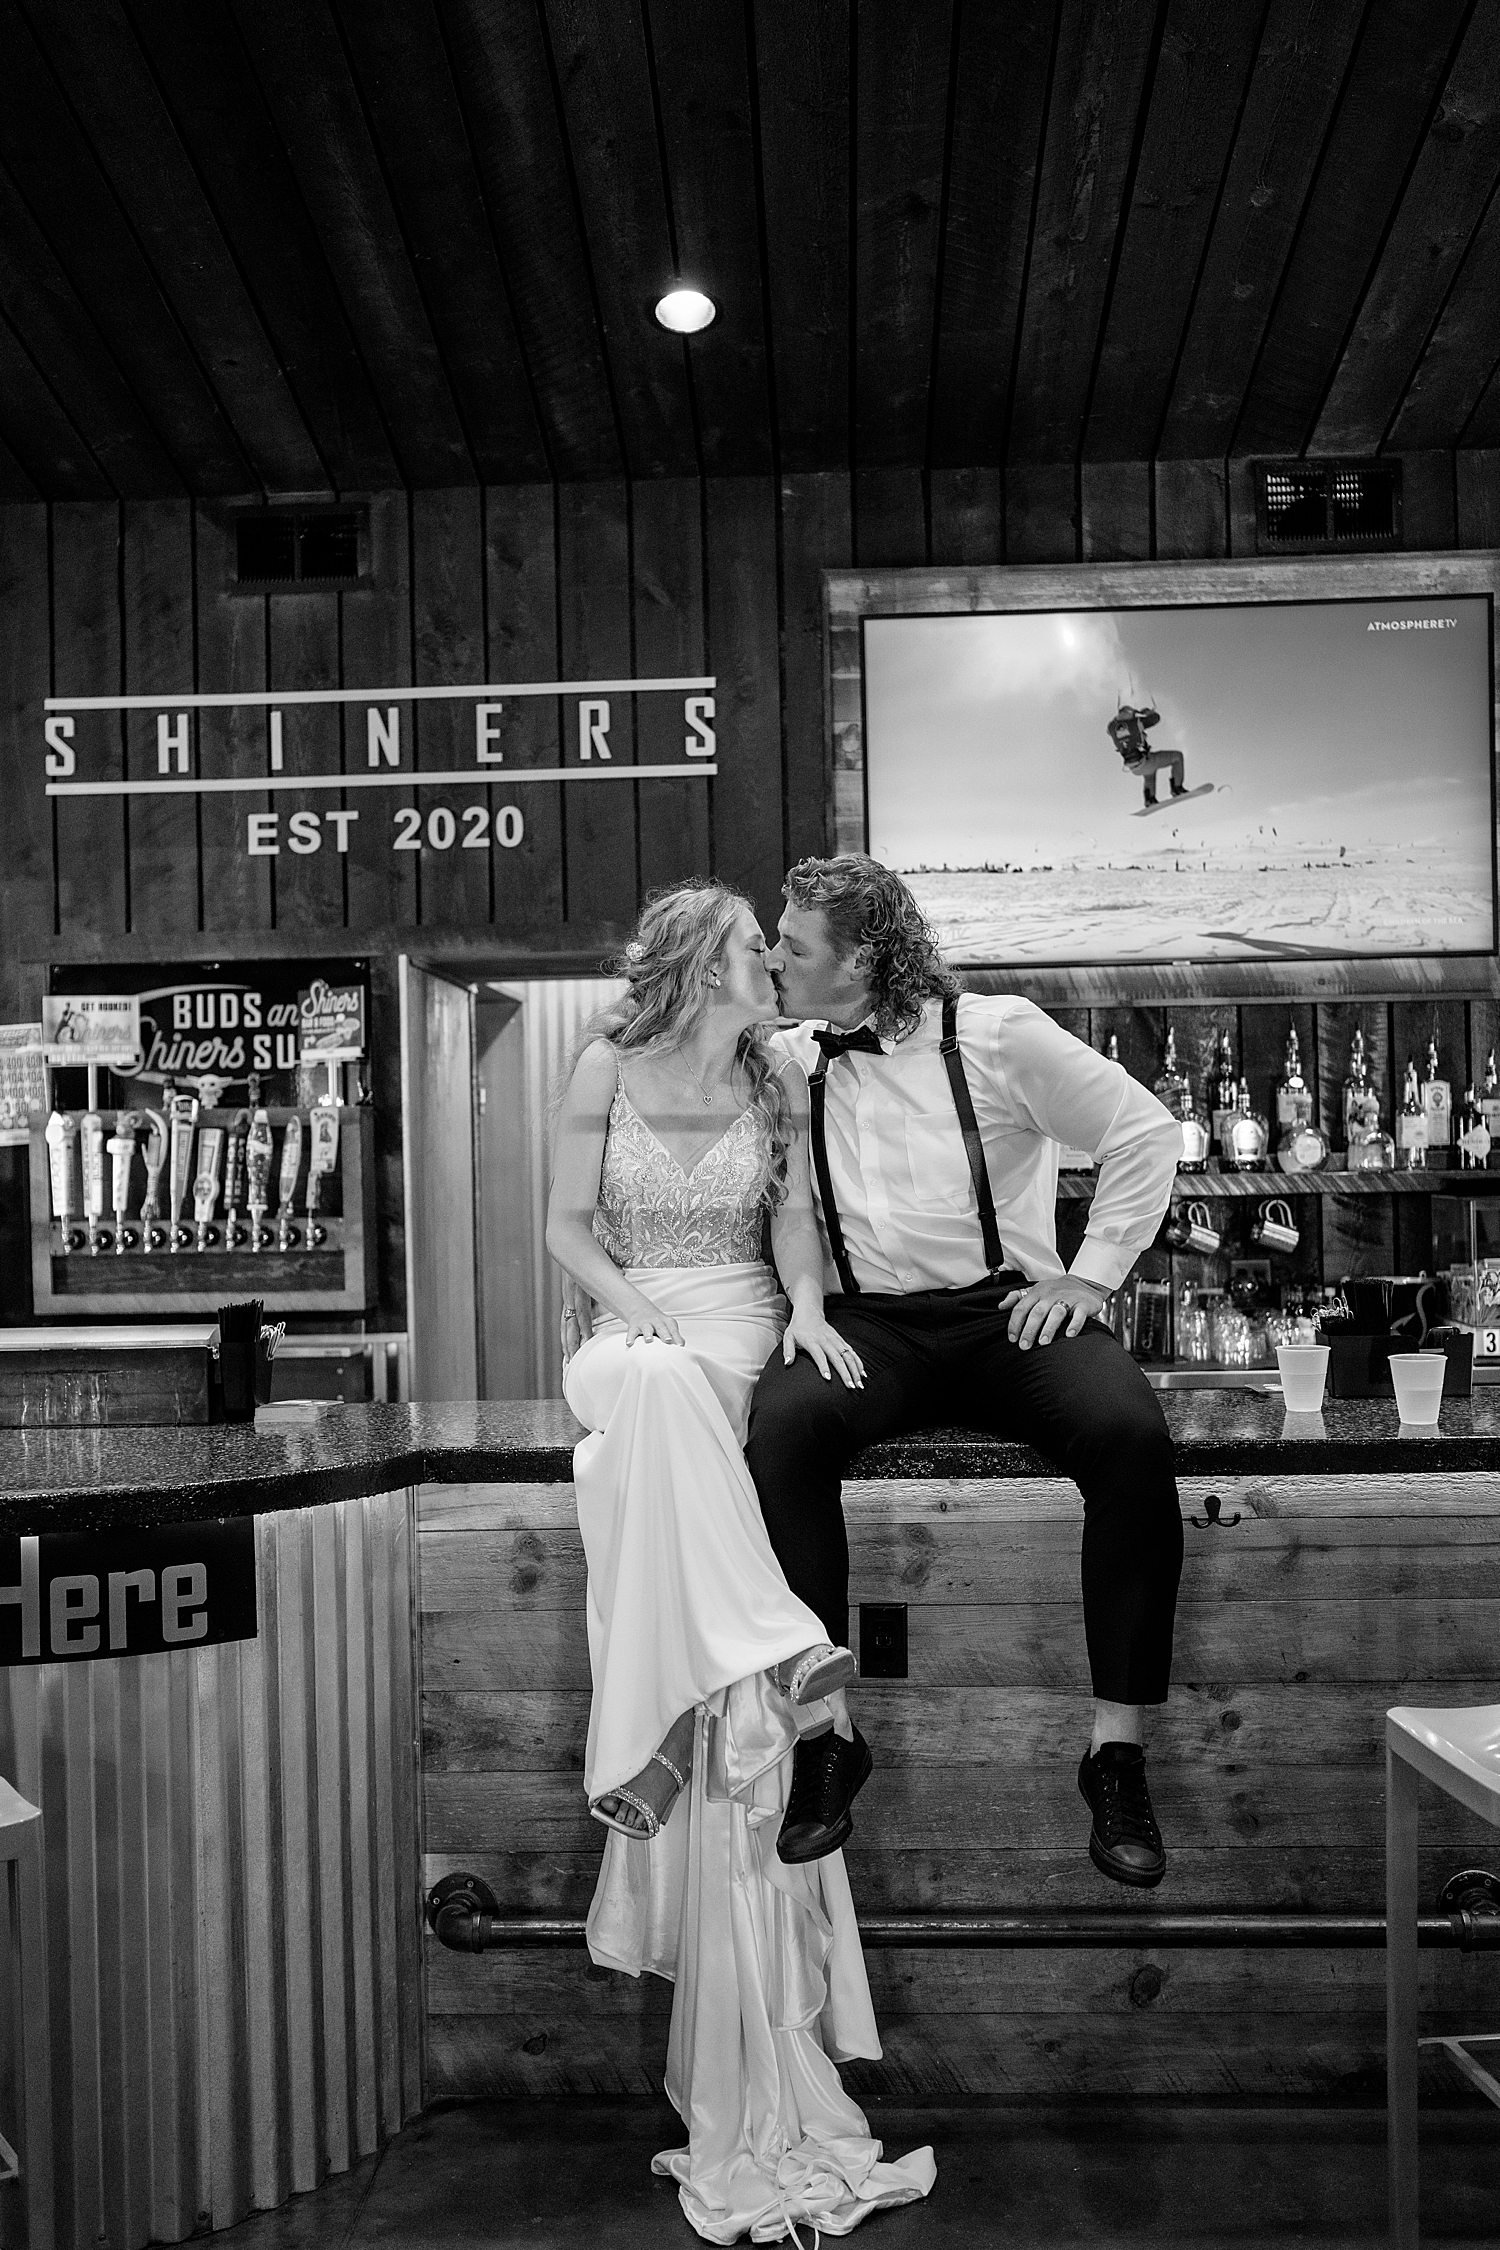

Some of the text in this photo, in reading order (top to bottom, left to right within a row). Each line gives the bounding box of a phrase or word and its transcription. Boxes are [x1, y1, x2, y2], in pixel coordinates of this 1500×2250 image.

[44, 696, 717, 777] SHINERS
[247, 805, 524, 856] EST 2020
[172, 991, 300, 1030] BUDS an
[301, 980, 359, 1018] Shiners
[1485, 1331, 1497, 1353] 3
[0, 1535, 208, 1658] Here
